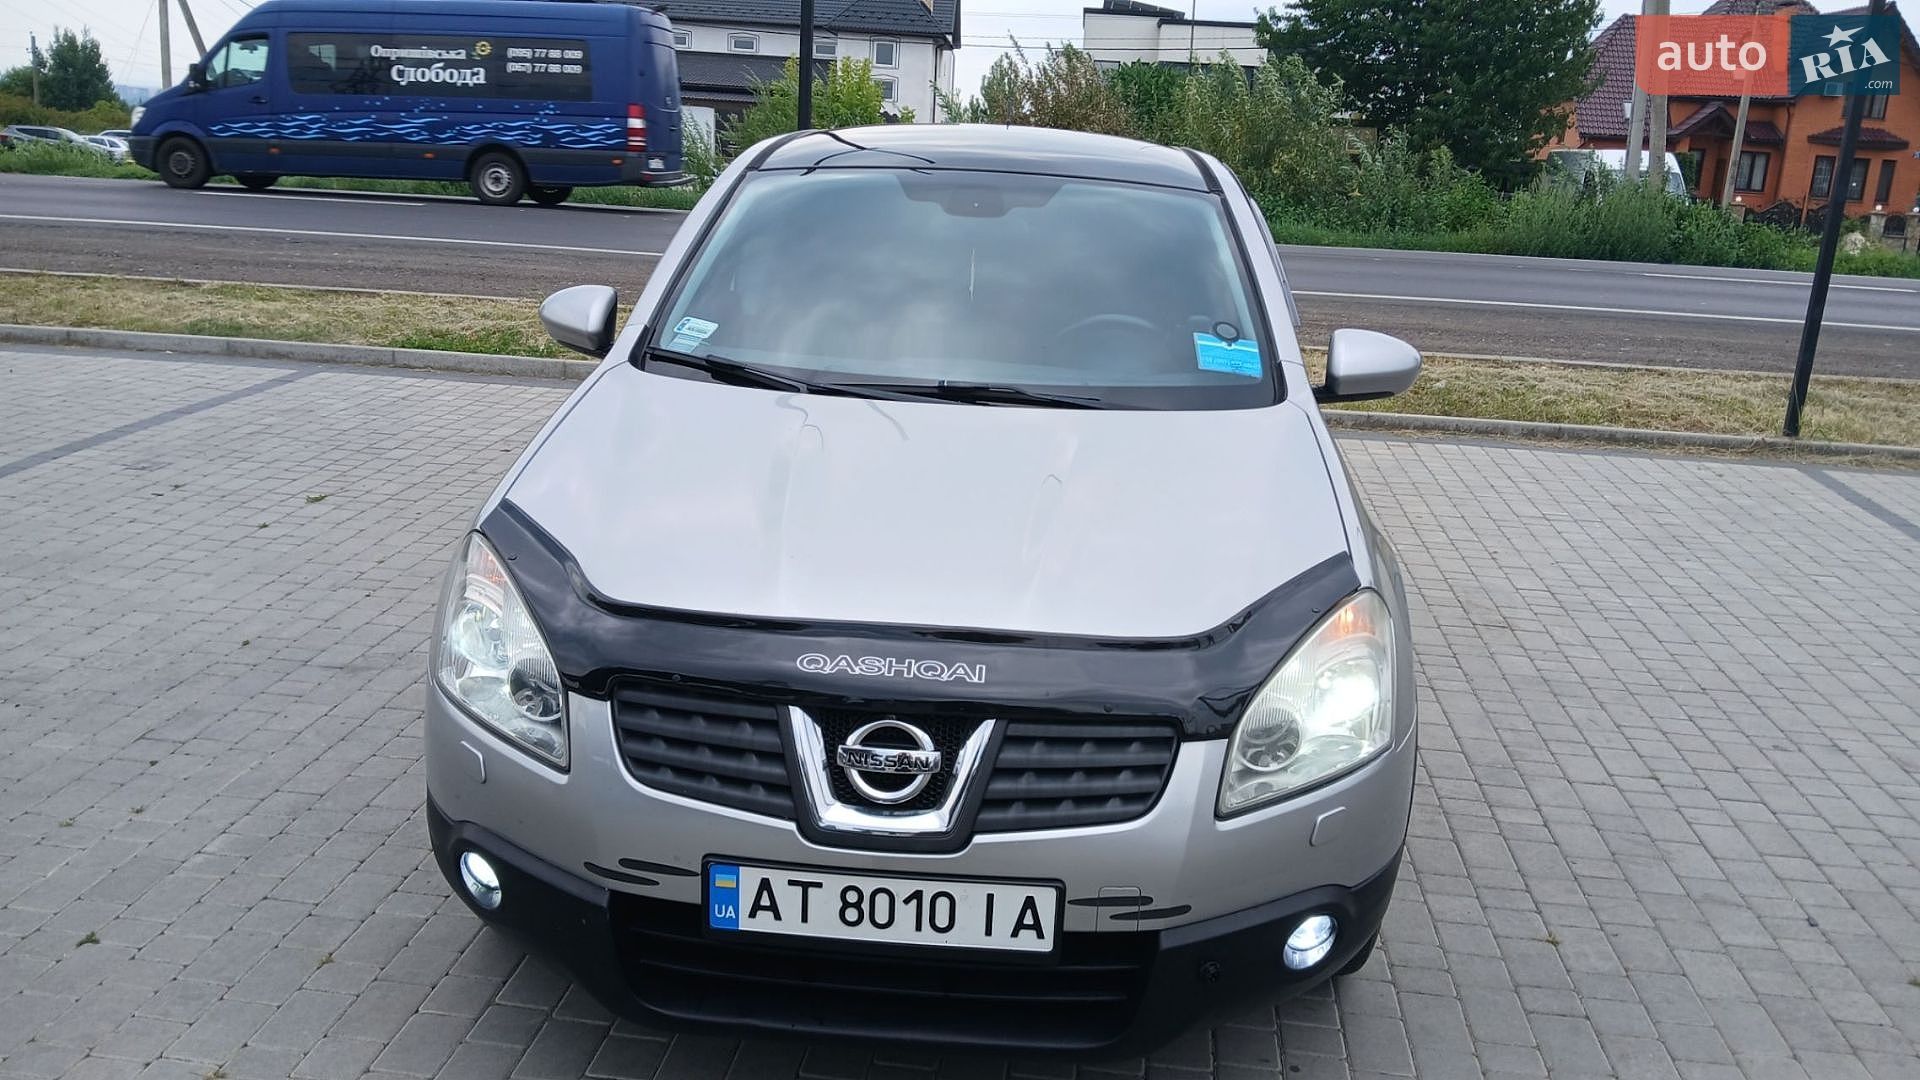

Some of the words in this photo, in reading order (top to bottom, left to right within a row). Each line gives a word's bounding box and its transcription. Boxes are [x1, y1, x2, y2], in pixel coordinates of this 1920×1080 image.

[390, 62, 487, 87] Слобода
[797, 653, 986, 684] QASHQAI
[847, 752, 930, 770] NISSAN
[714, 904, 736, 919] UA
[748, 877, 824, 924] AT
[838, 884, 956, 934] 8010
[984, 893, 1046, 940] IA
